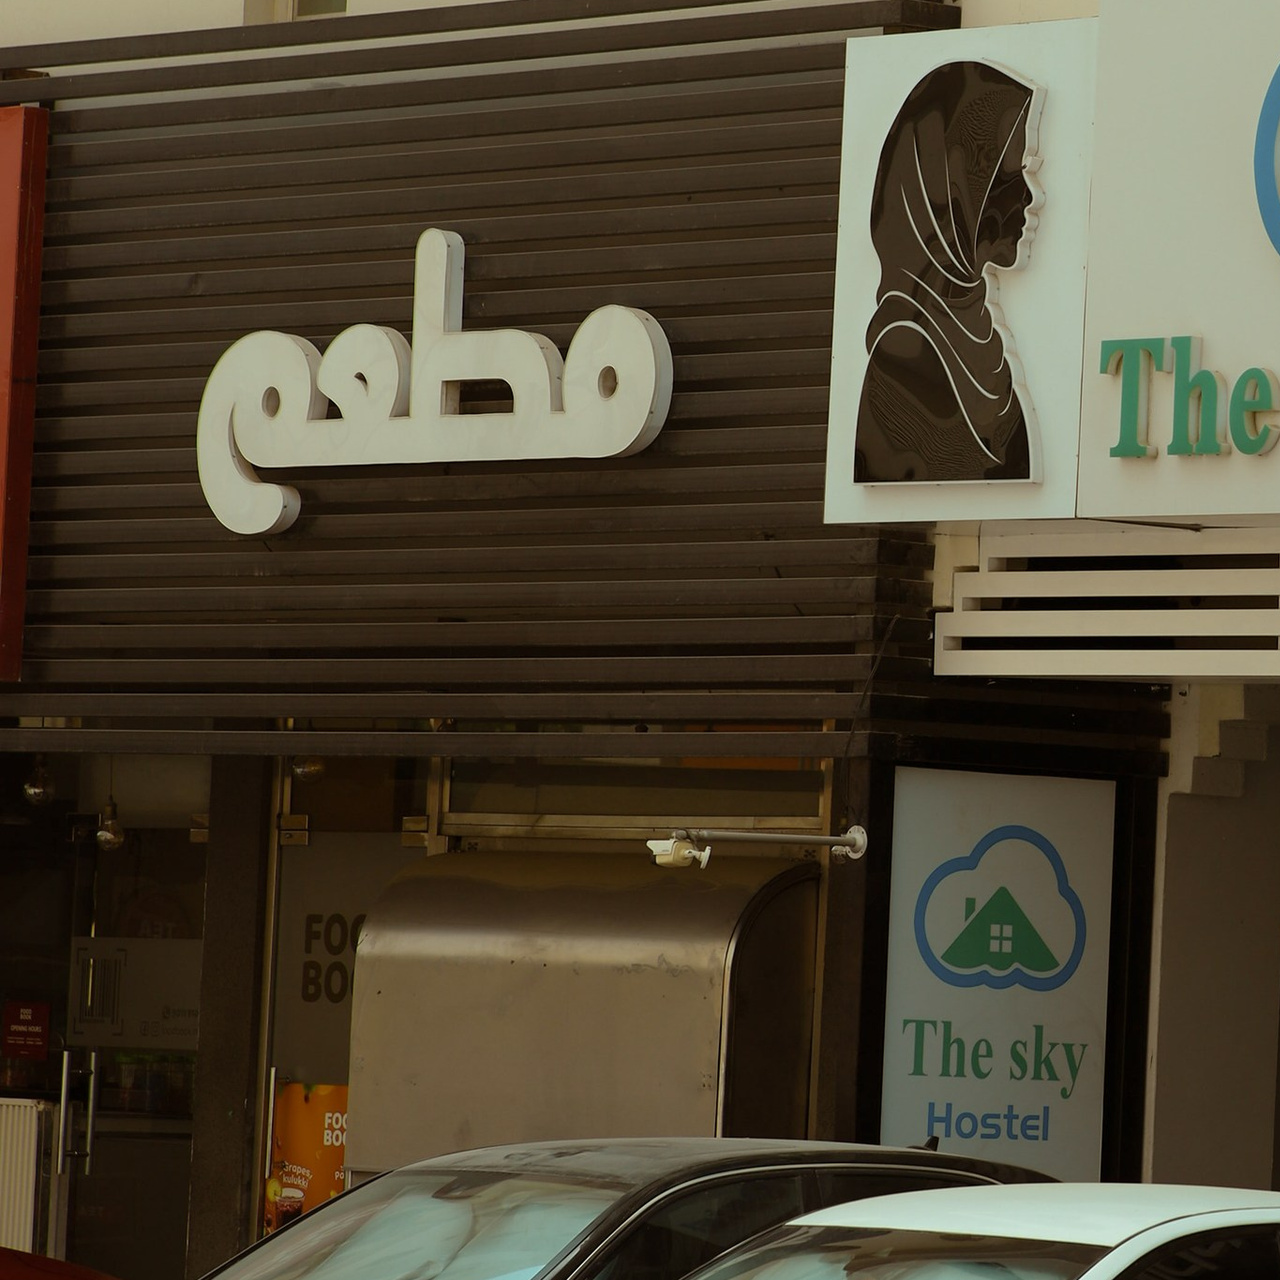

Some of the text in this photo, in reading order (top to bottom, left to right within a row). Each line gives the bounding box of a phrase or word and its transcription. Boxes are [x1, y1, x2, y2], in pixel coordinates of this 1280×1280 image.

[197, 228, 674, 535] مطعم
[301, 959, 354, 1004] BO
[903, 1019, 1088, 1099] The sky
[927, 1102, 1049, 1141] Hostel
